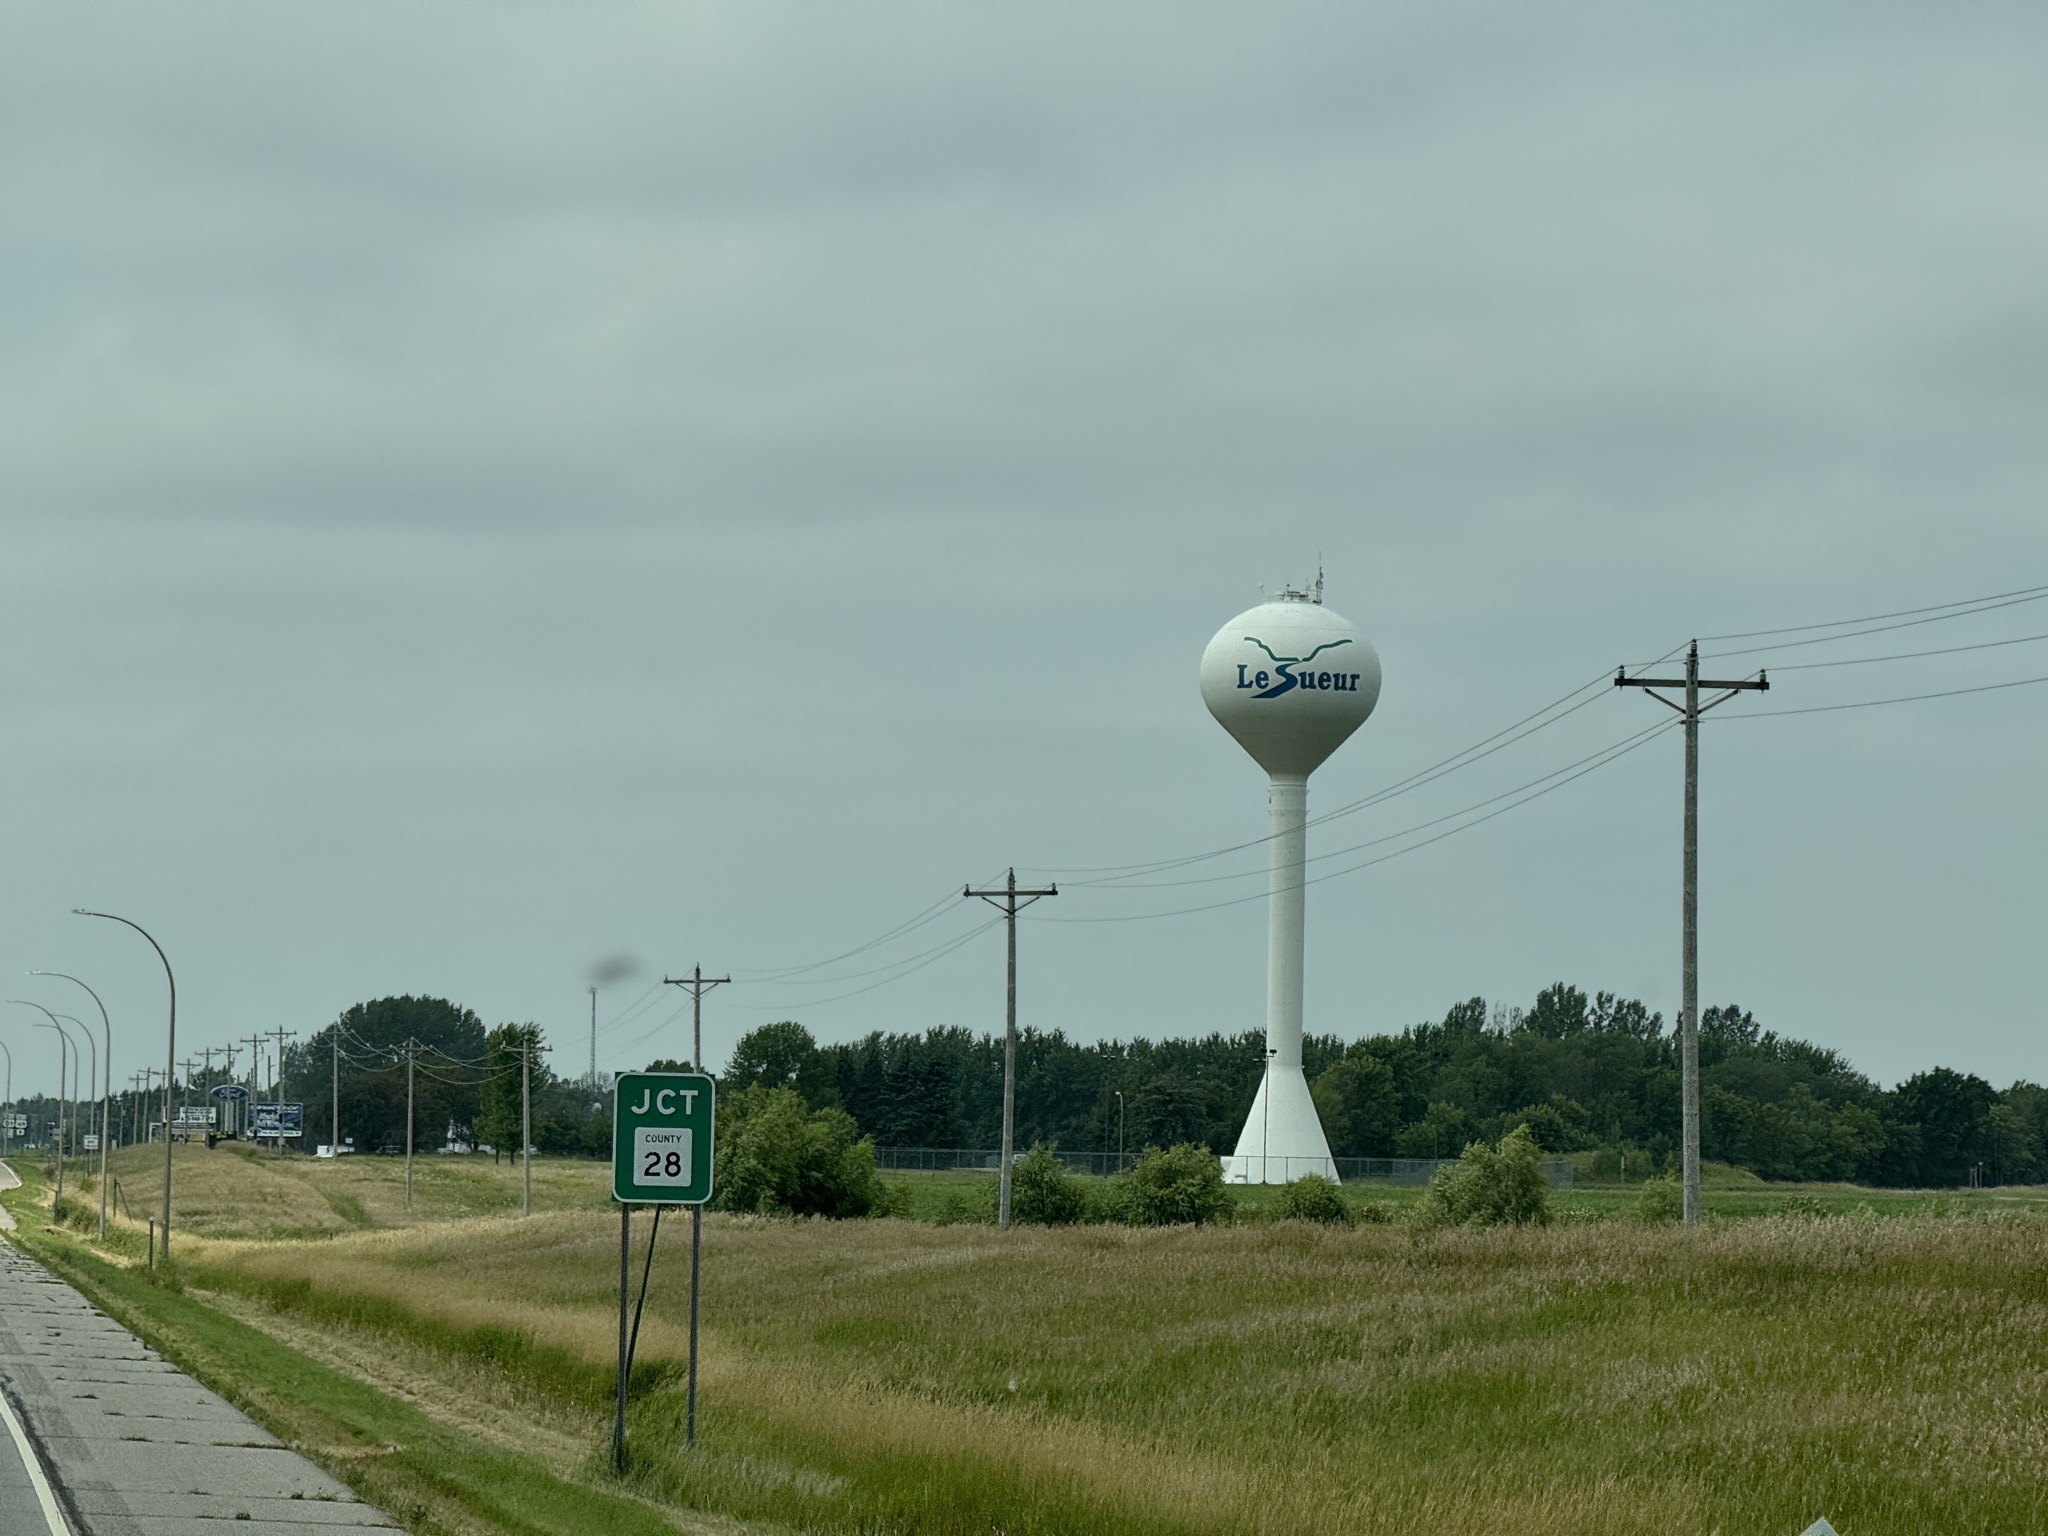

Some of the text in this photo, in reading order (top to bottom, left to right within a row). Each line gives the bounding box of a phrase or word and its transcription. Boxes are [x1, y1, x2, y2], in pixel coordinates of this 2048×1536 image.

[1237, 661, 1361, 699] Le Sueur
[631, 1089, 699, 1115] JCT
[645, 1134, 682, 1143] COUNTY
[644, 1152, 682, 1177] 28
